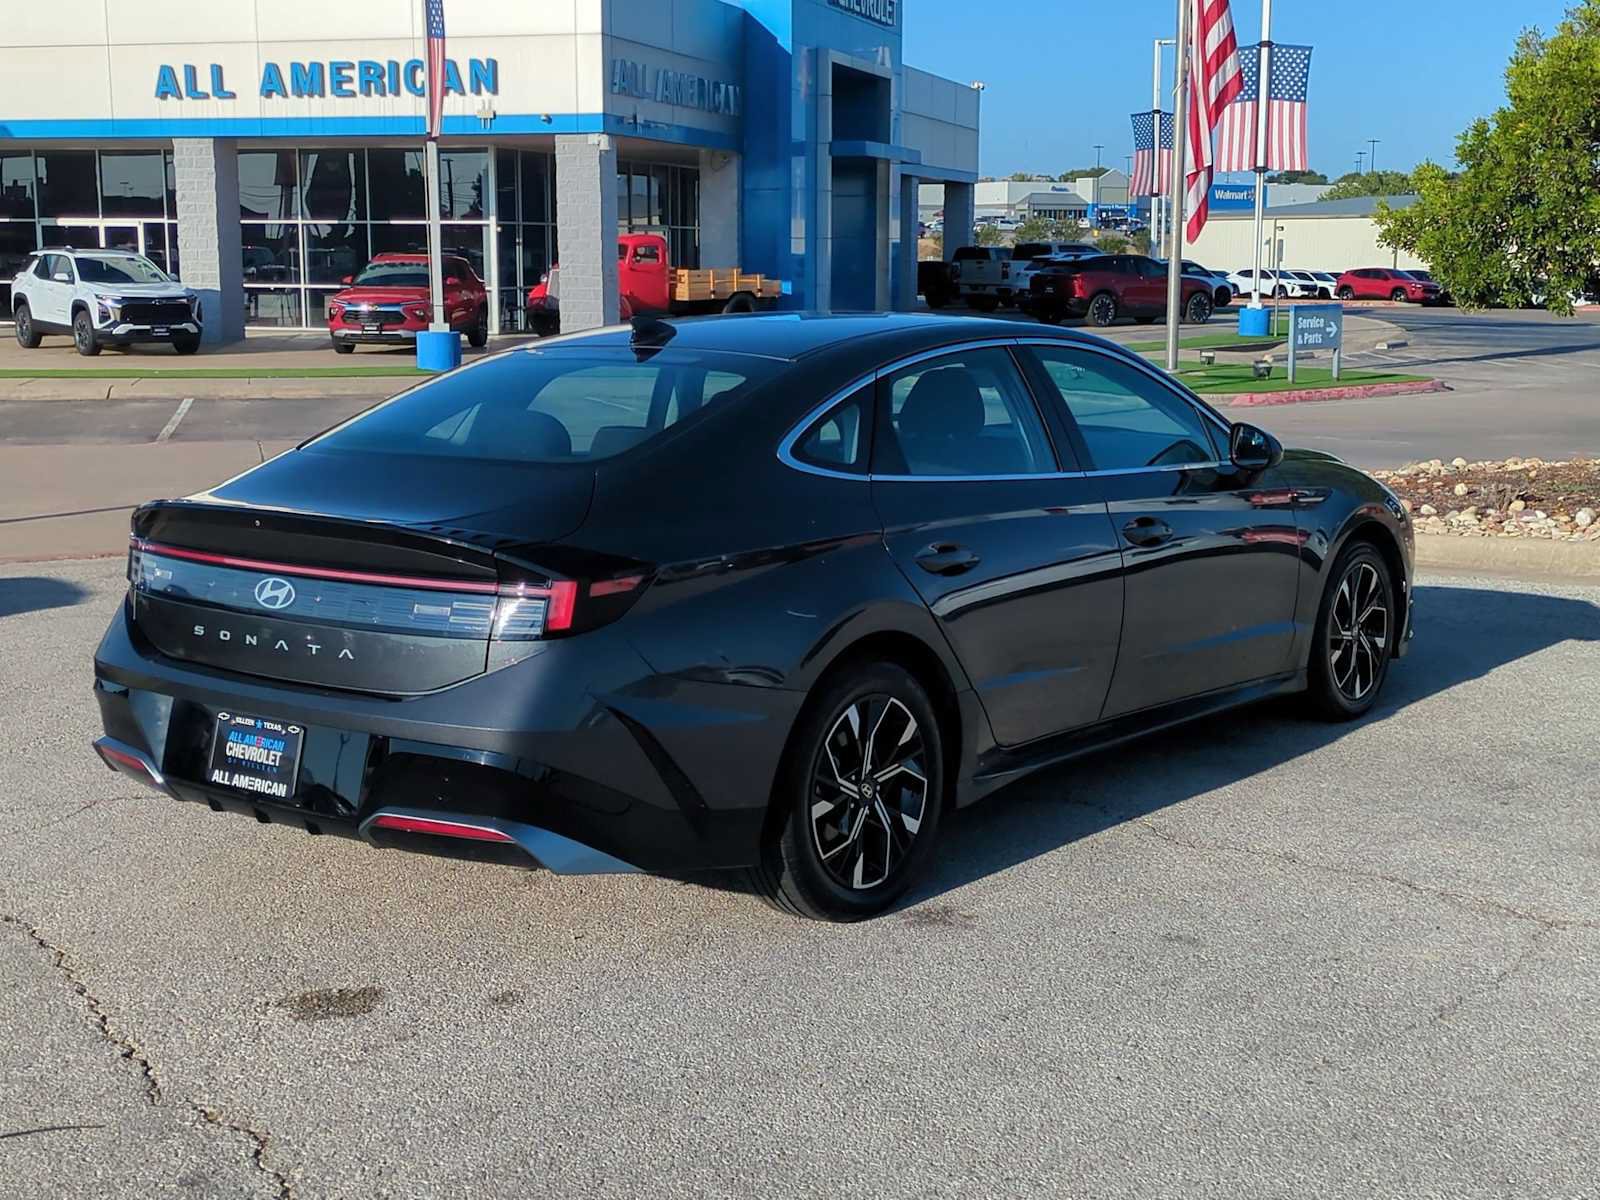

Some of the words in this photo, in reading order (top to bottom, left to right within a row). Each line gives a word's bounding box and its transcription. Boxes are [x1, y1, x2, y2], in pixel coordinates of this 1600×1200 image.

[839, 0, 897, 26] VROLET
[154, 63, 237, 100] ALL
[260, 58, 499, 98] AMERICAN
[609, 59, 655, 99] ALL
[1215, 188, 1248, 200] Walmart
[1297, 316, 1325, 329] Service
[1297, 334, 1303, 345] &
[1303, 332, 1323, 345] Parts
[193, 625, 355, 660] SONATA
[263, 721, 282, 731] TEXAS
[228, 730, 243, 743] ALL
[243, 734, 286, 751] AMERICAN
[225, 741, 283, 767] CHEVROLET
[211, 769, 231, 786] ALL
[231, 773, 288, 798] AMERICAN
